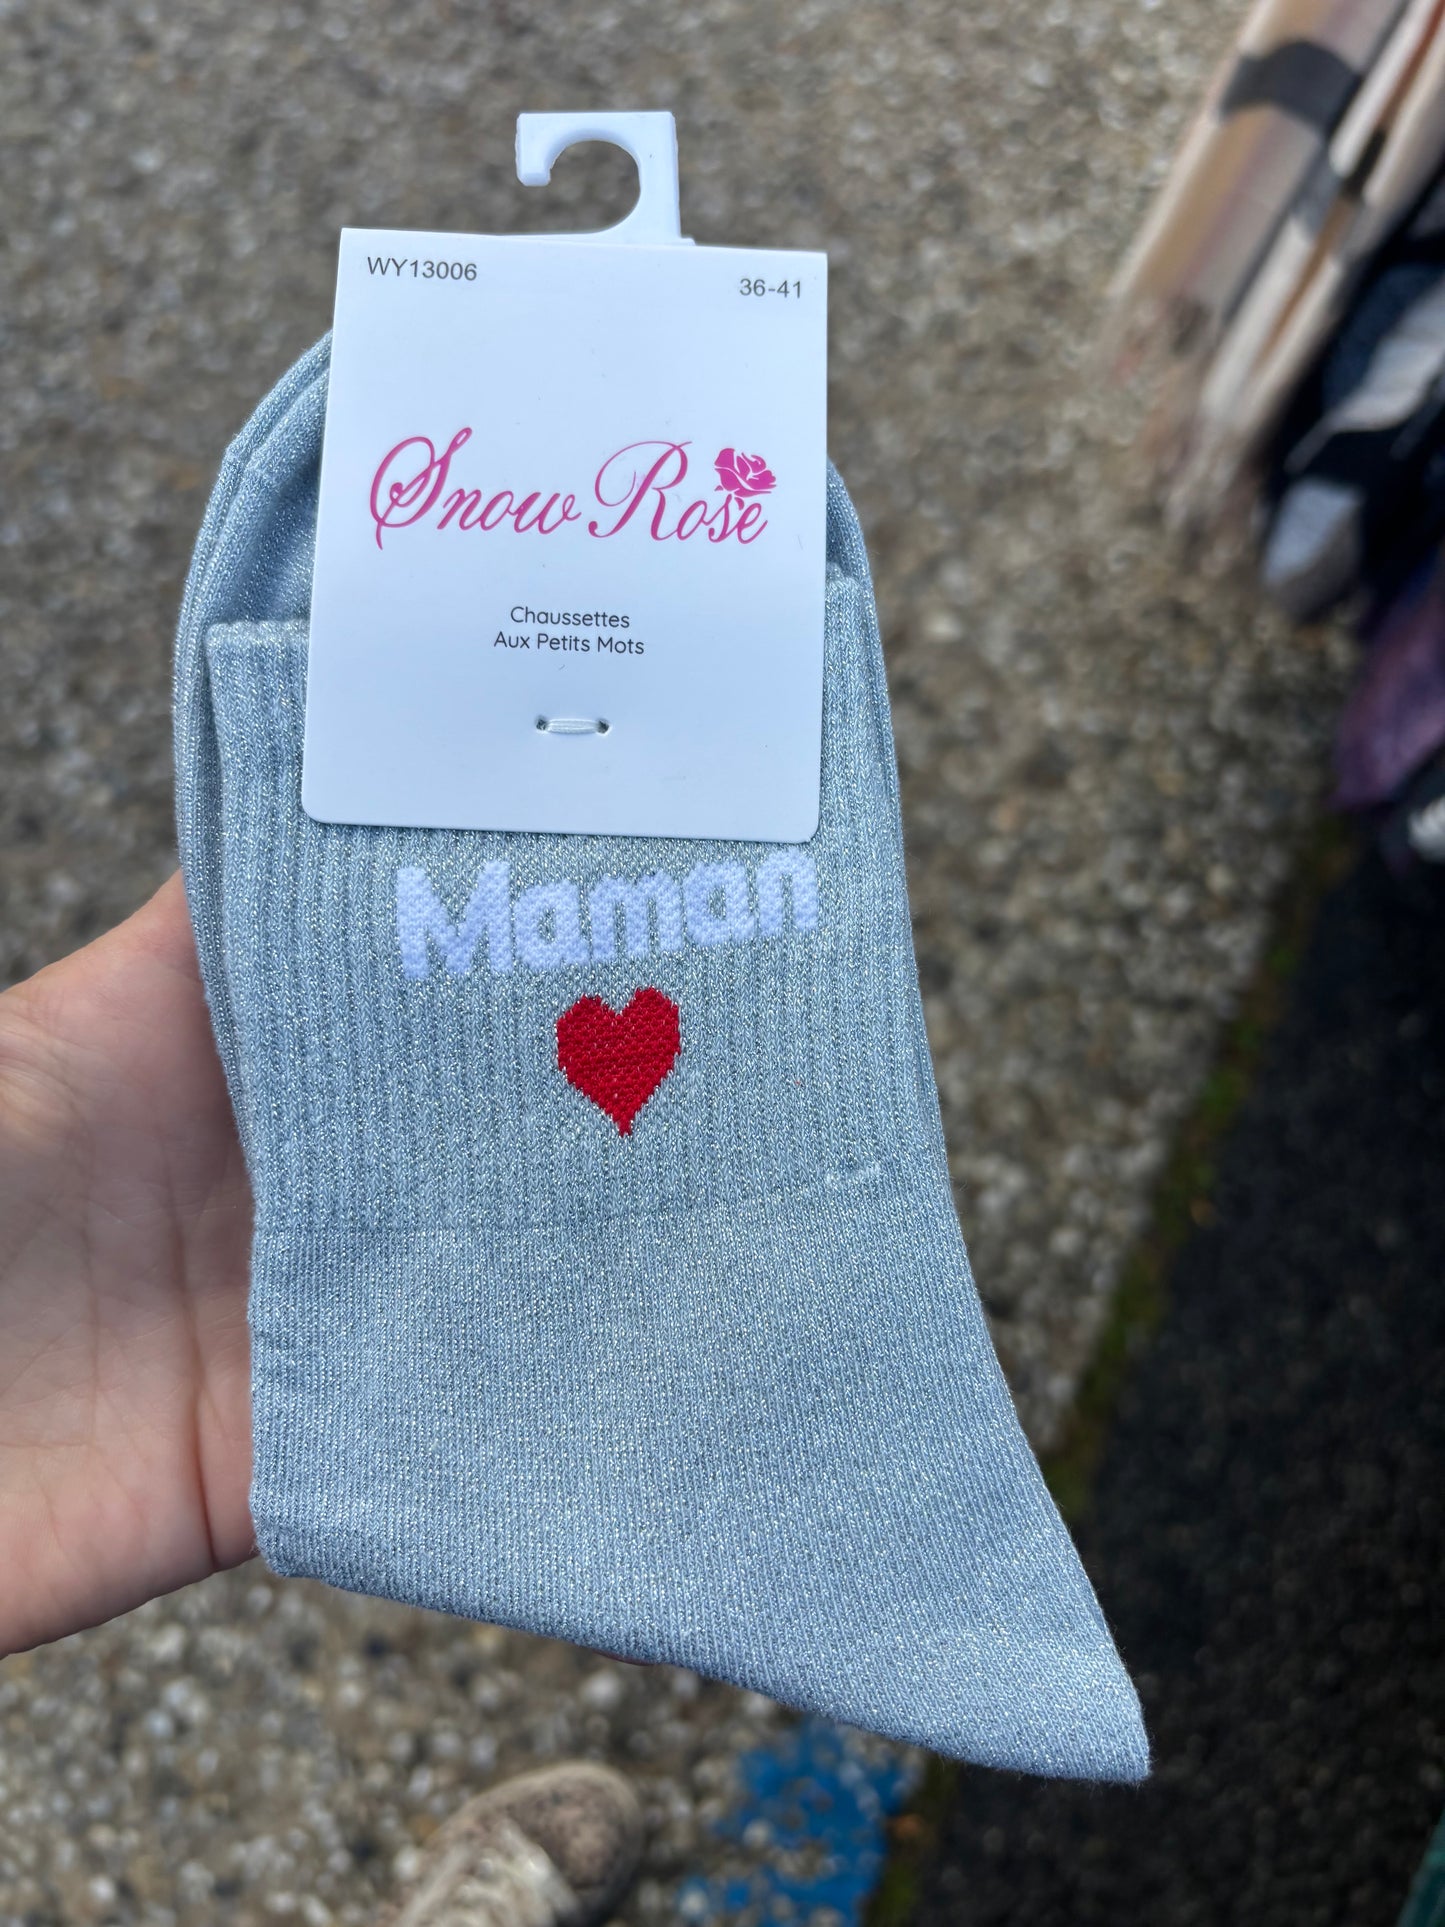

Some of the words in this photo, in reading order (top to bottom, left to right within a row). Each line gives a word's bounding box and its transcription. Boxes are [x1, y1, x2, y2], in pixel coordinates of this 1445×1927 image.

[367, 256, 478, 282] WY13006
[739, 278, 803, 299] 36-41
[369, 426, 582, 551] Snow
[588, 440, 769, 545] Rose
[510, 605, 630, 629] Chaussettes
[493, 630, 531, 651] Aux
[537, 632, 591, 653] Petits
[597, 634, 645, 655] Mots
[396, 847, 819, 981] Maman
